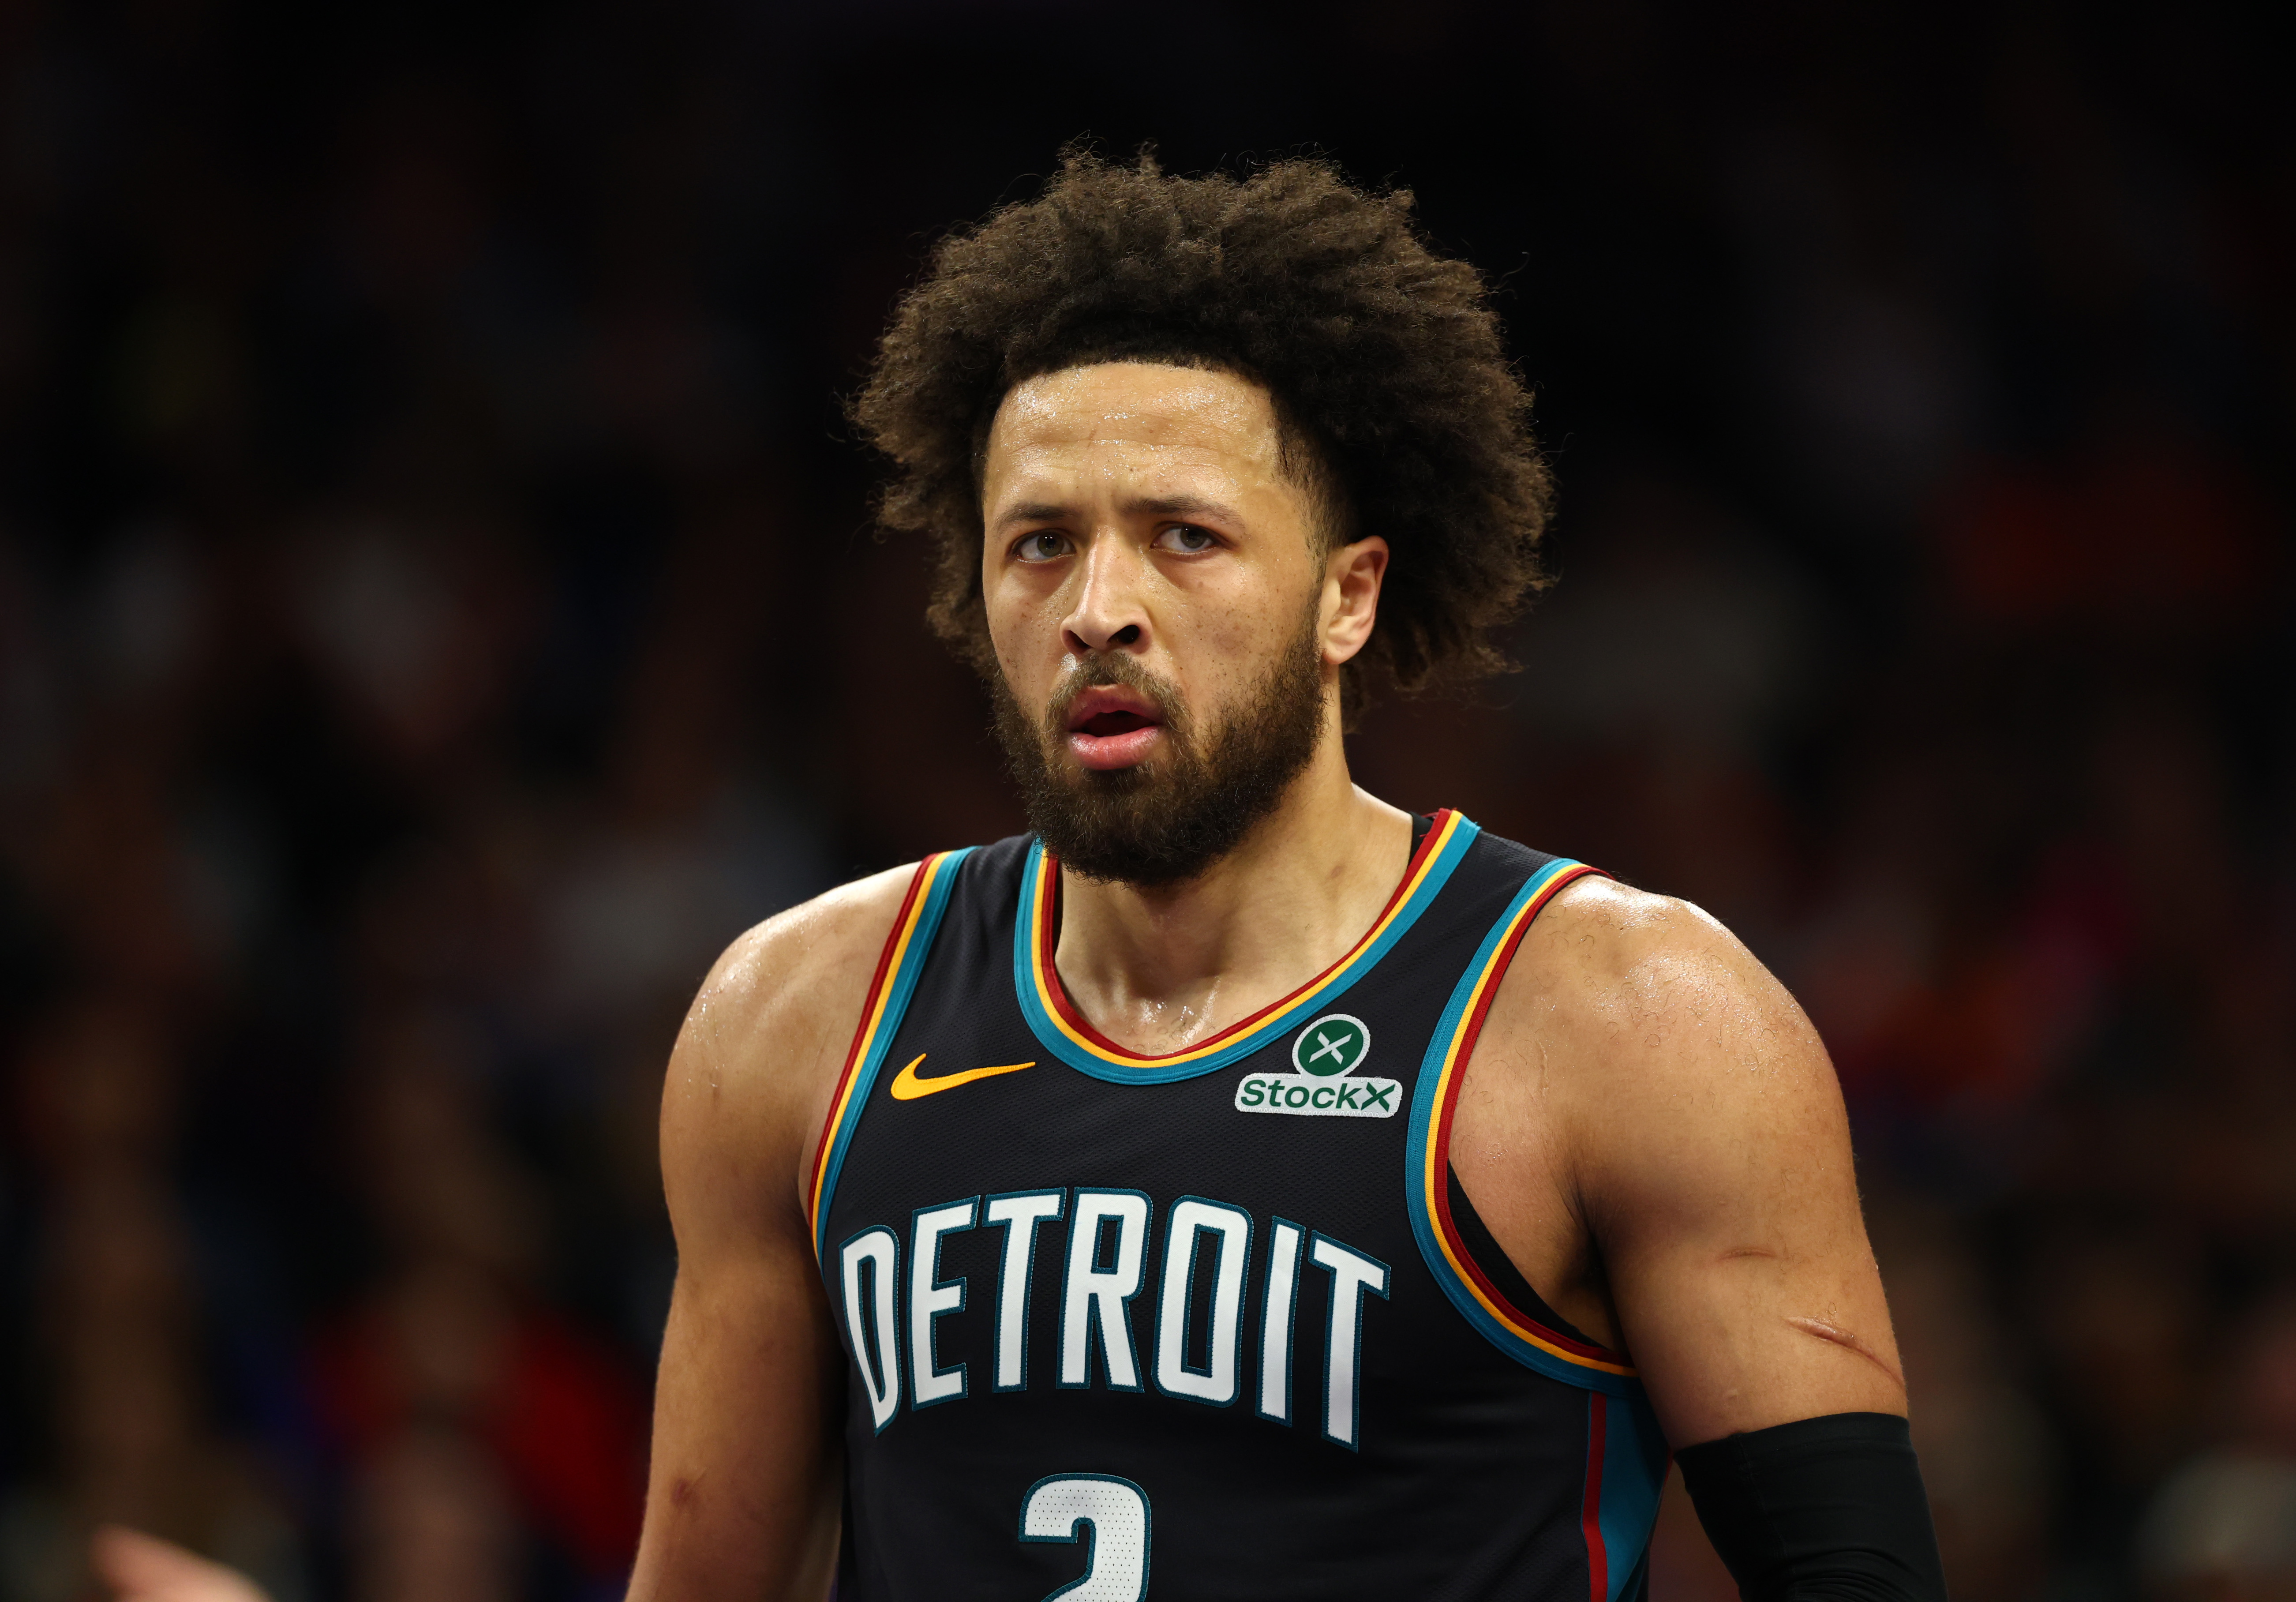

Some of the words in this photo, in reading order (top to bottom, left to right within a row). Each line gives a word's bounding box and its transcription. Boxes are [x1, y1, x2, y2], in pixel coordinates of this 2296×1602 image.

[1308, 1031, 1352, 1065] X
[1240, 1079, 1396, 1112] StockX
[839, 1187, 1391, 1453] DETROIT
[1019, 1473, 1151, 1602] 2
